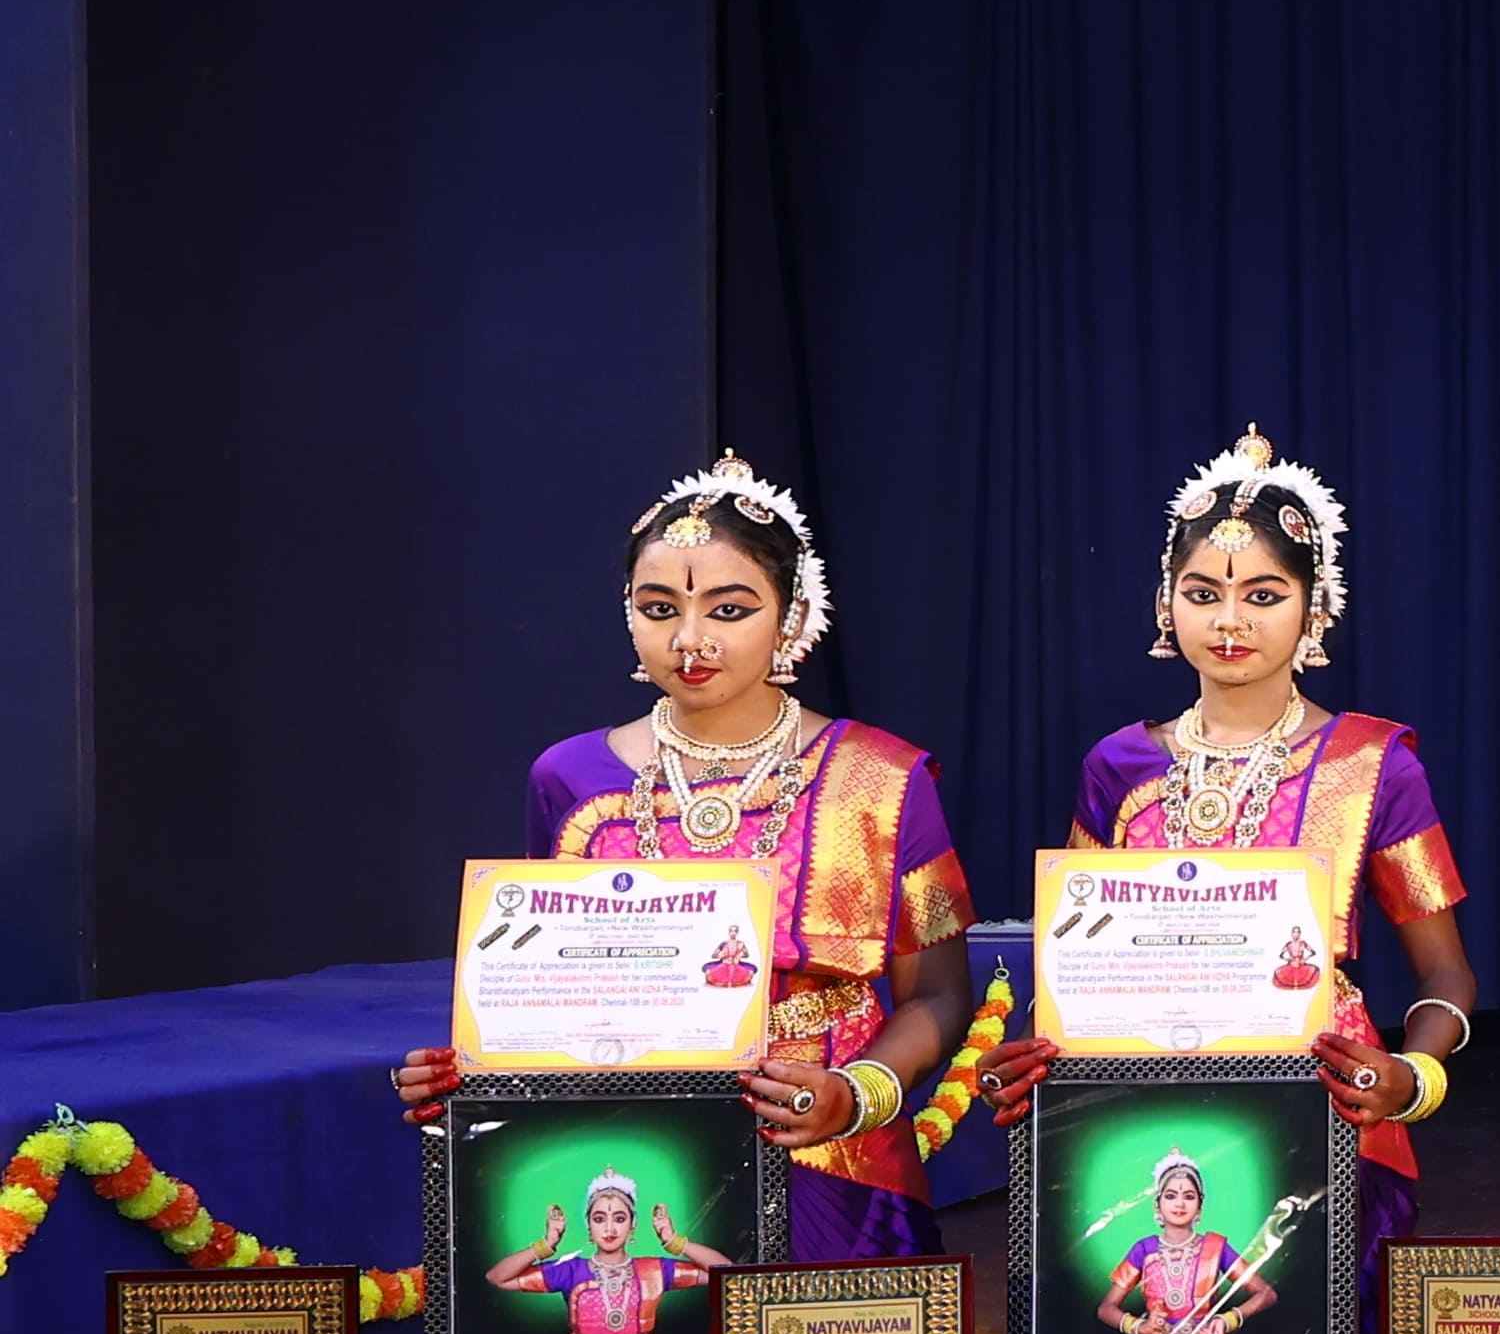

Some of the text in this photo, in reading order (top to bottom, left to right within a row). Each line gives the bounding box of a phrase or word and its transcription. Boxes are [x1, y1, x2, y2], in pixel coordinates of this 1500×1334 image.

[529, 889, 717, 914] NATYAVIJAYAM
[1100, 878, 1278, 903] NATYAVIJAYAM
[583, 916, 616, 924] School
[633, 916, 656, 924] Arts
